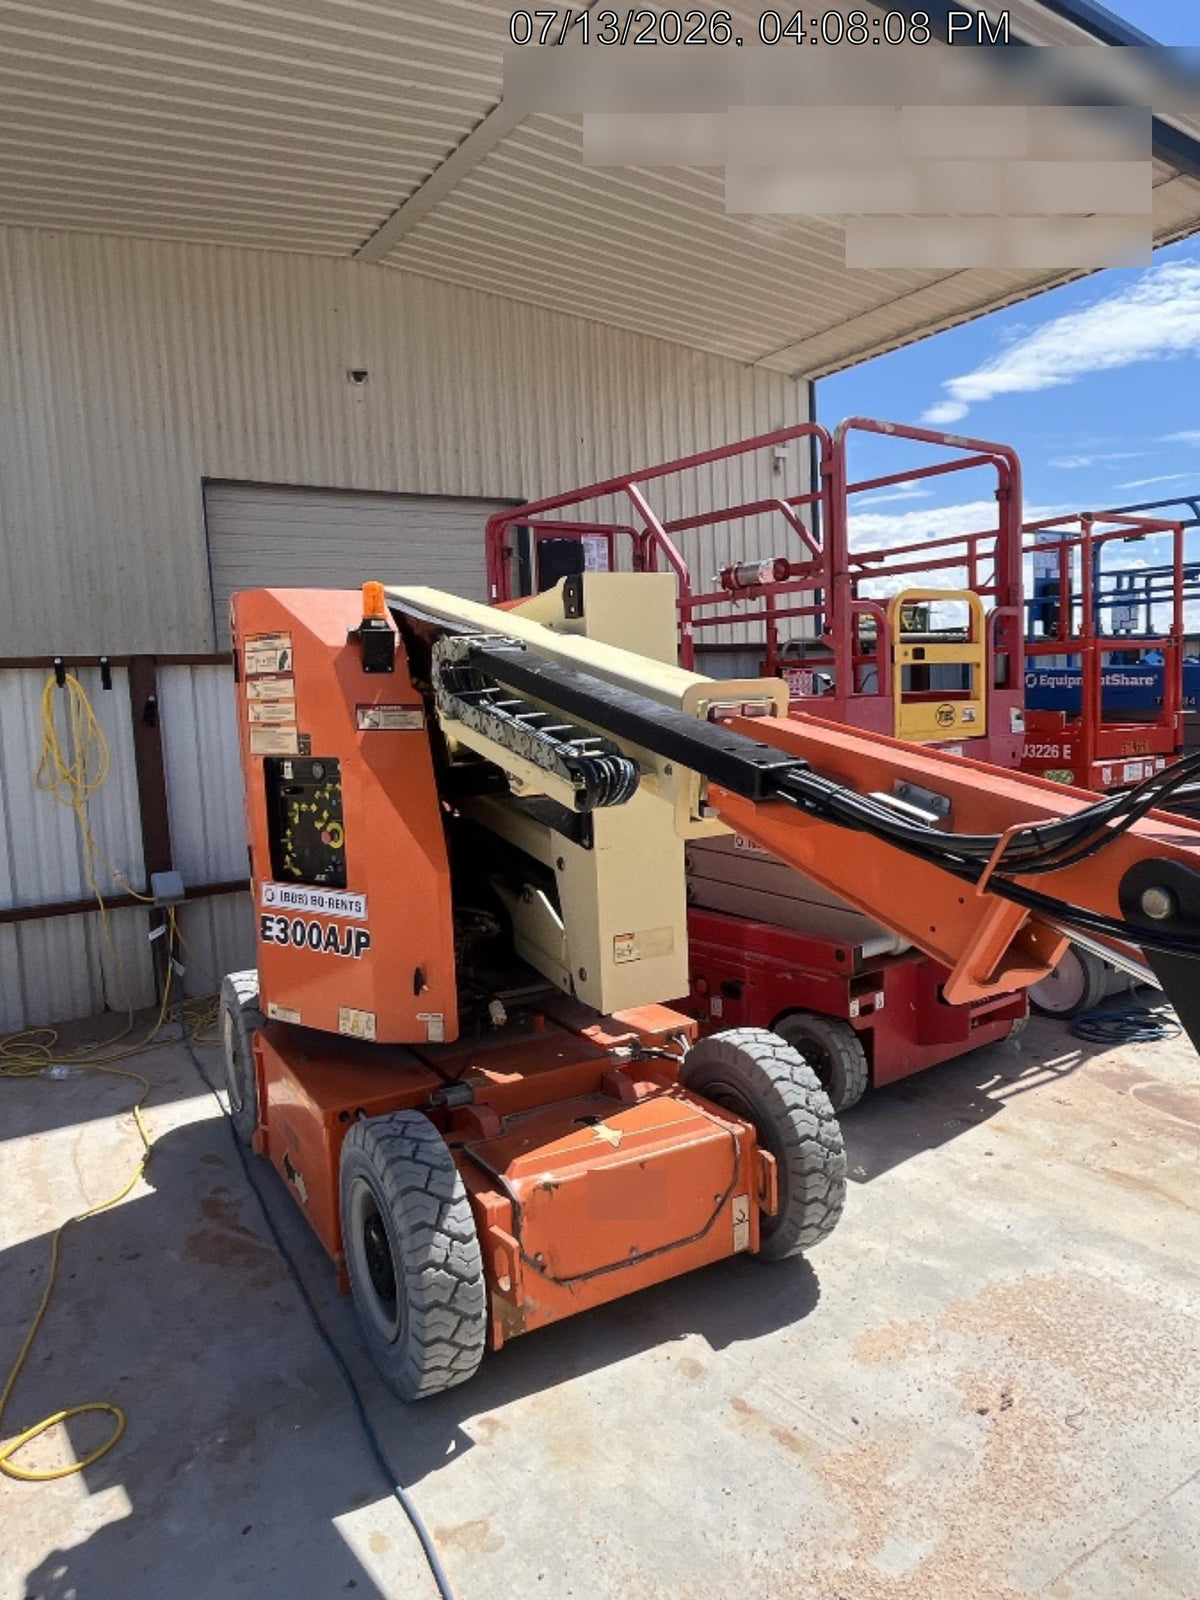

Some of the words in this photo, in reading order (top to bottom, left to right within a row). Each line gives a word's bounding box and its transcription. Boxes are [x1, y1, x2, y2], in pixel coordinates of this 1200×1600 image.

[1039, 673, 1154, 689] EquiptShare
[1063, 744, 1071, 760] E
[260, 913, 371, 960] E300AJP
